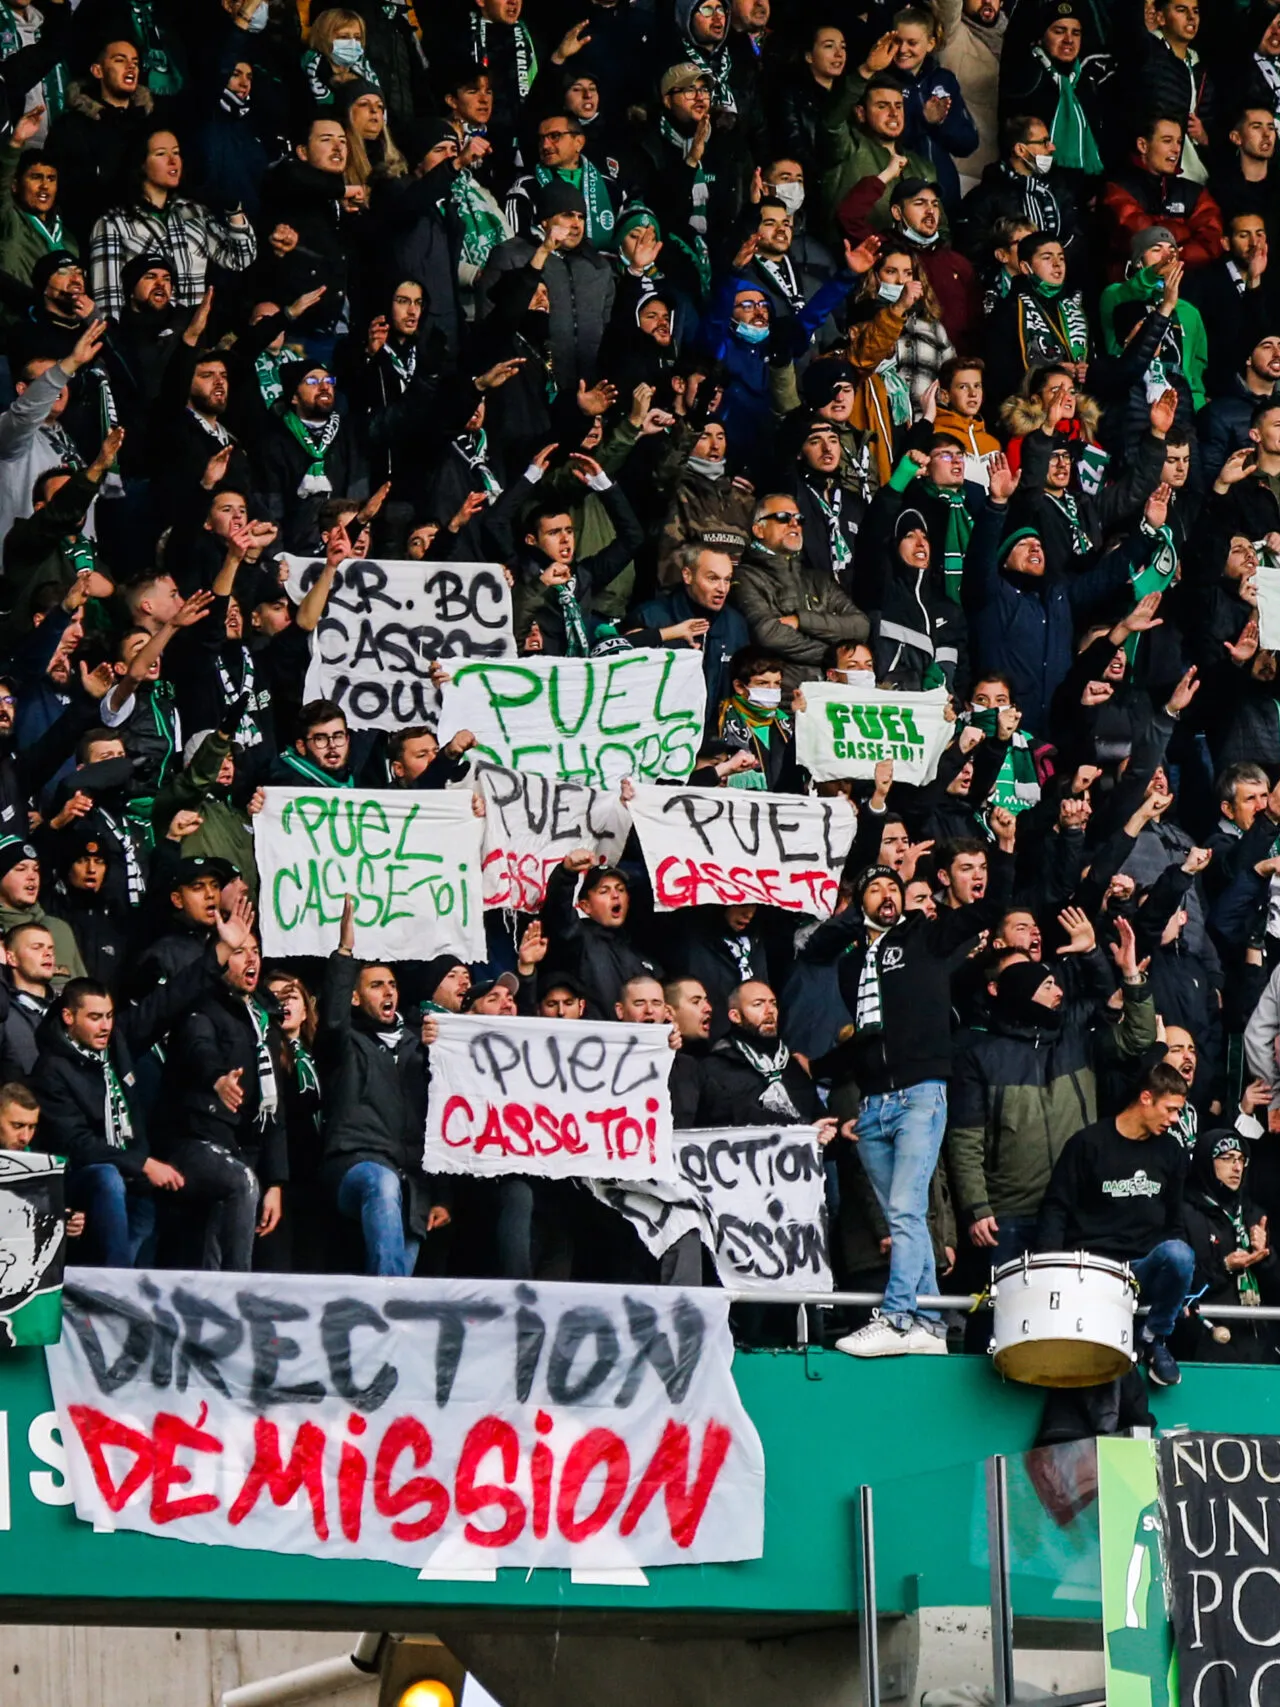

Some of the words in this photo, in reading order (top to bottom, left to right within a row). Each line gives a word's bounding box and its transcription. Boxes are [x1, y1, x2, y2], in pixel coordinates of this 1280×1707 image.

[424, 570, 508, 628] BC
[453, 651, 695, 744] PUEL
[826, 702, 925, 745] PUEL
[475, 760, 616, 841] PUEL
[662, 794, 847, 870] PUEL
[273, 858, 415, 931] CASSE
